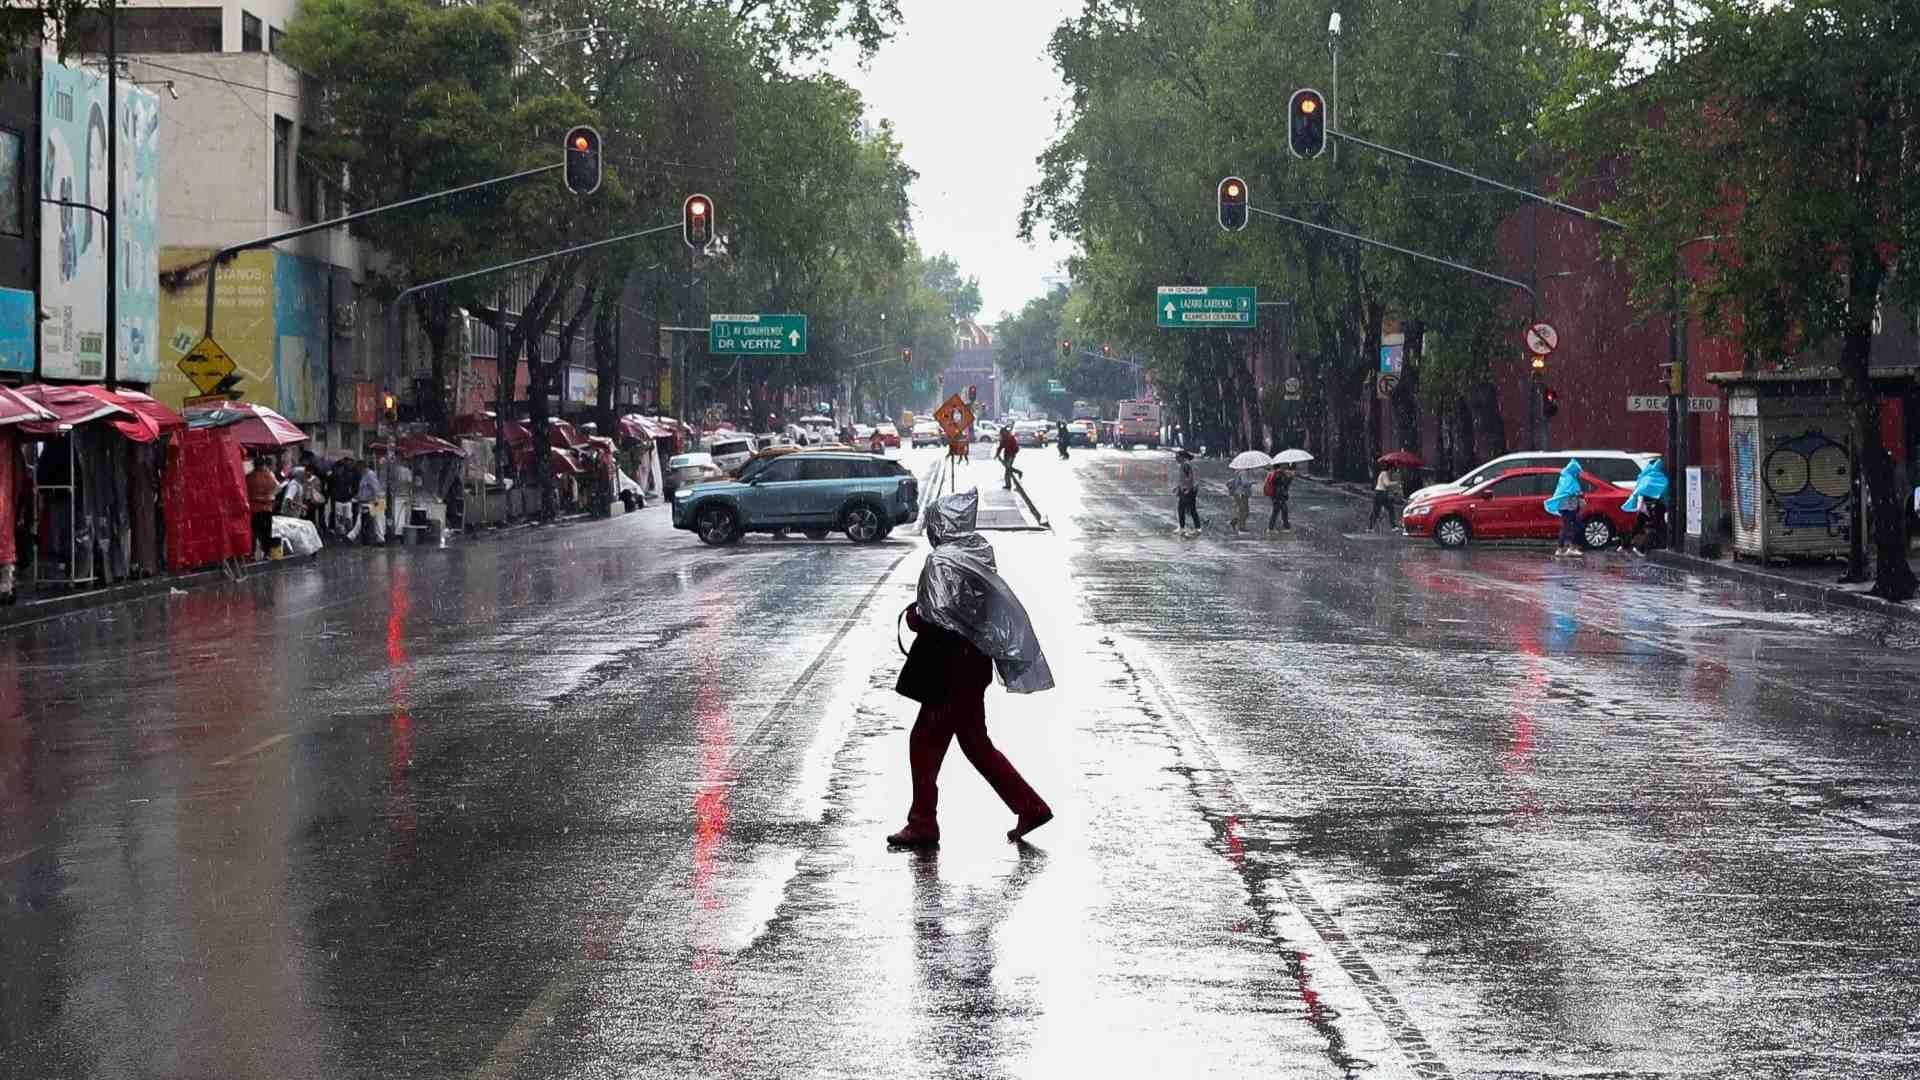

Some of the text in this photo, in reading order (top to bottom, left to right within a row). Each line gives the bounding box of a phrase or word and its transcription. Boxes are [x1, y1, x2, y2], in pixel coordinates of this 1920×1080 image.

[718, 338, 781, 349] DR VERTIZ
[1634, 398, 1641, 408] 5
